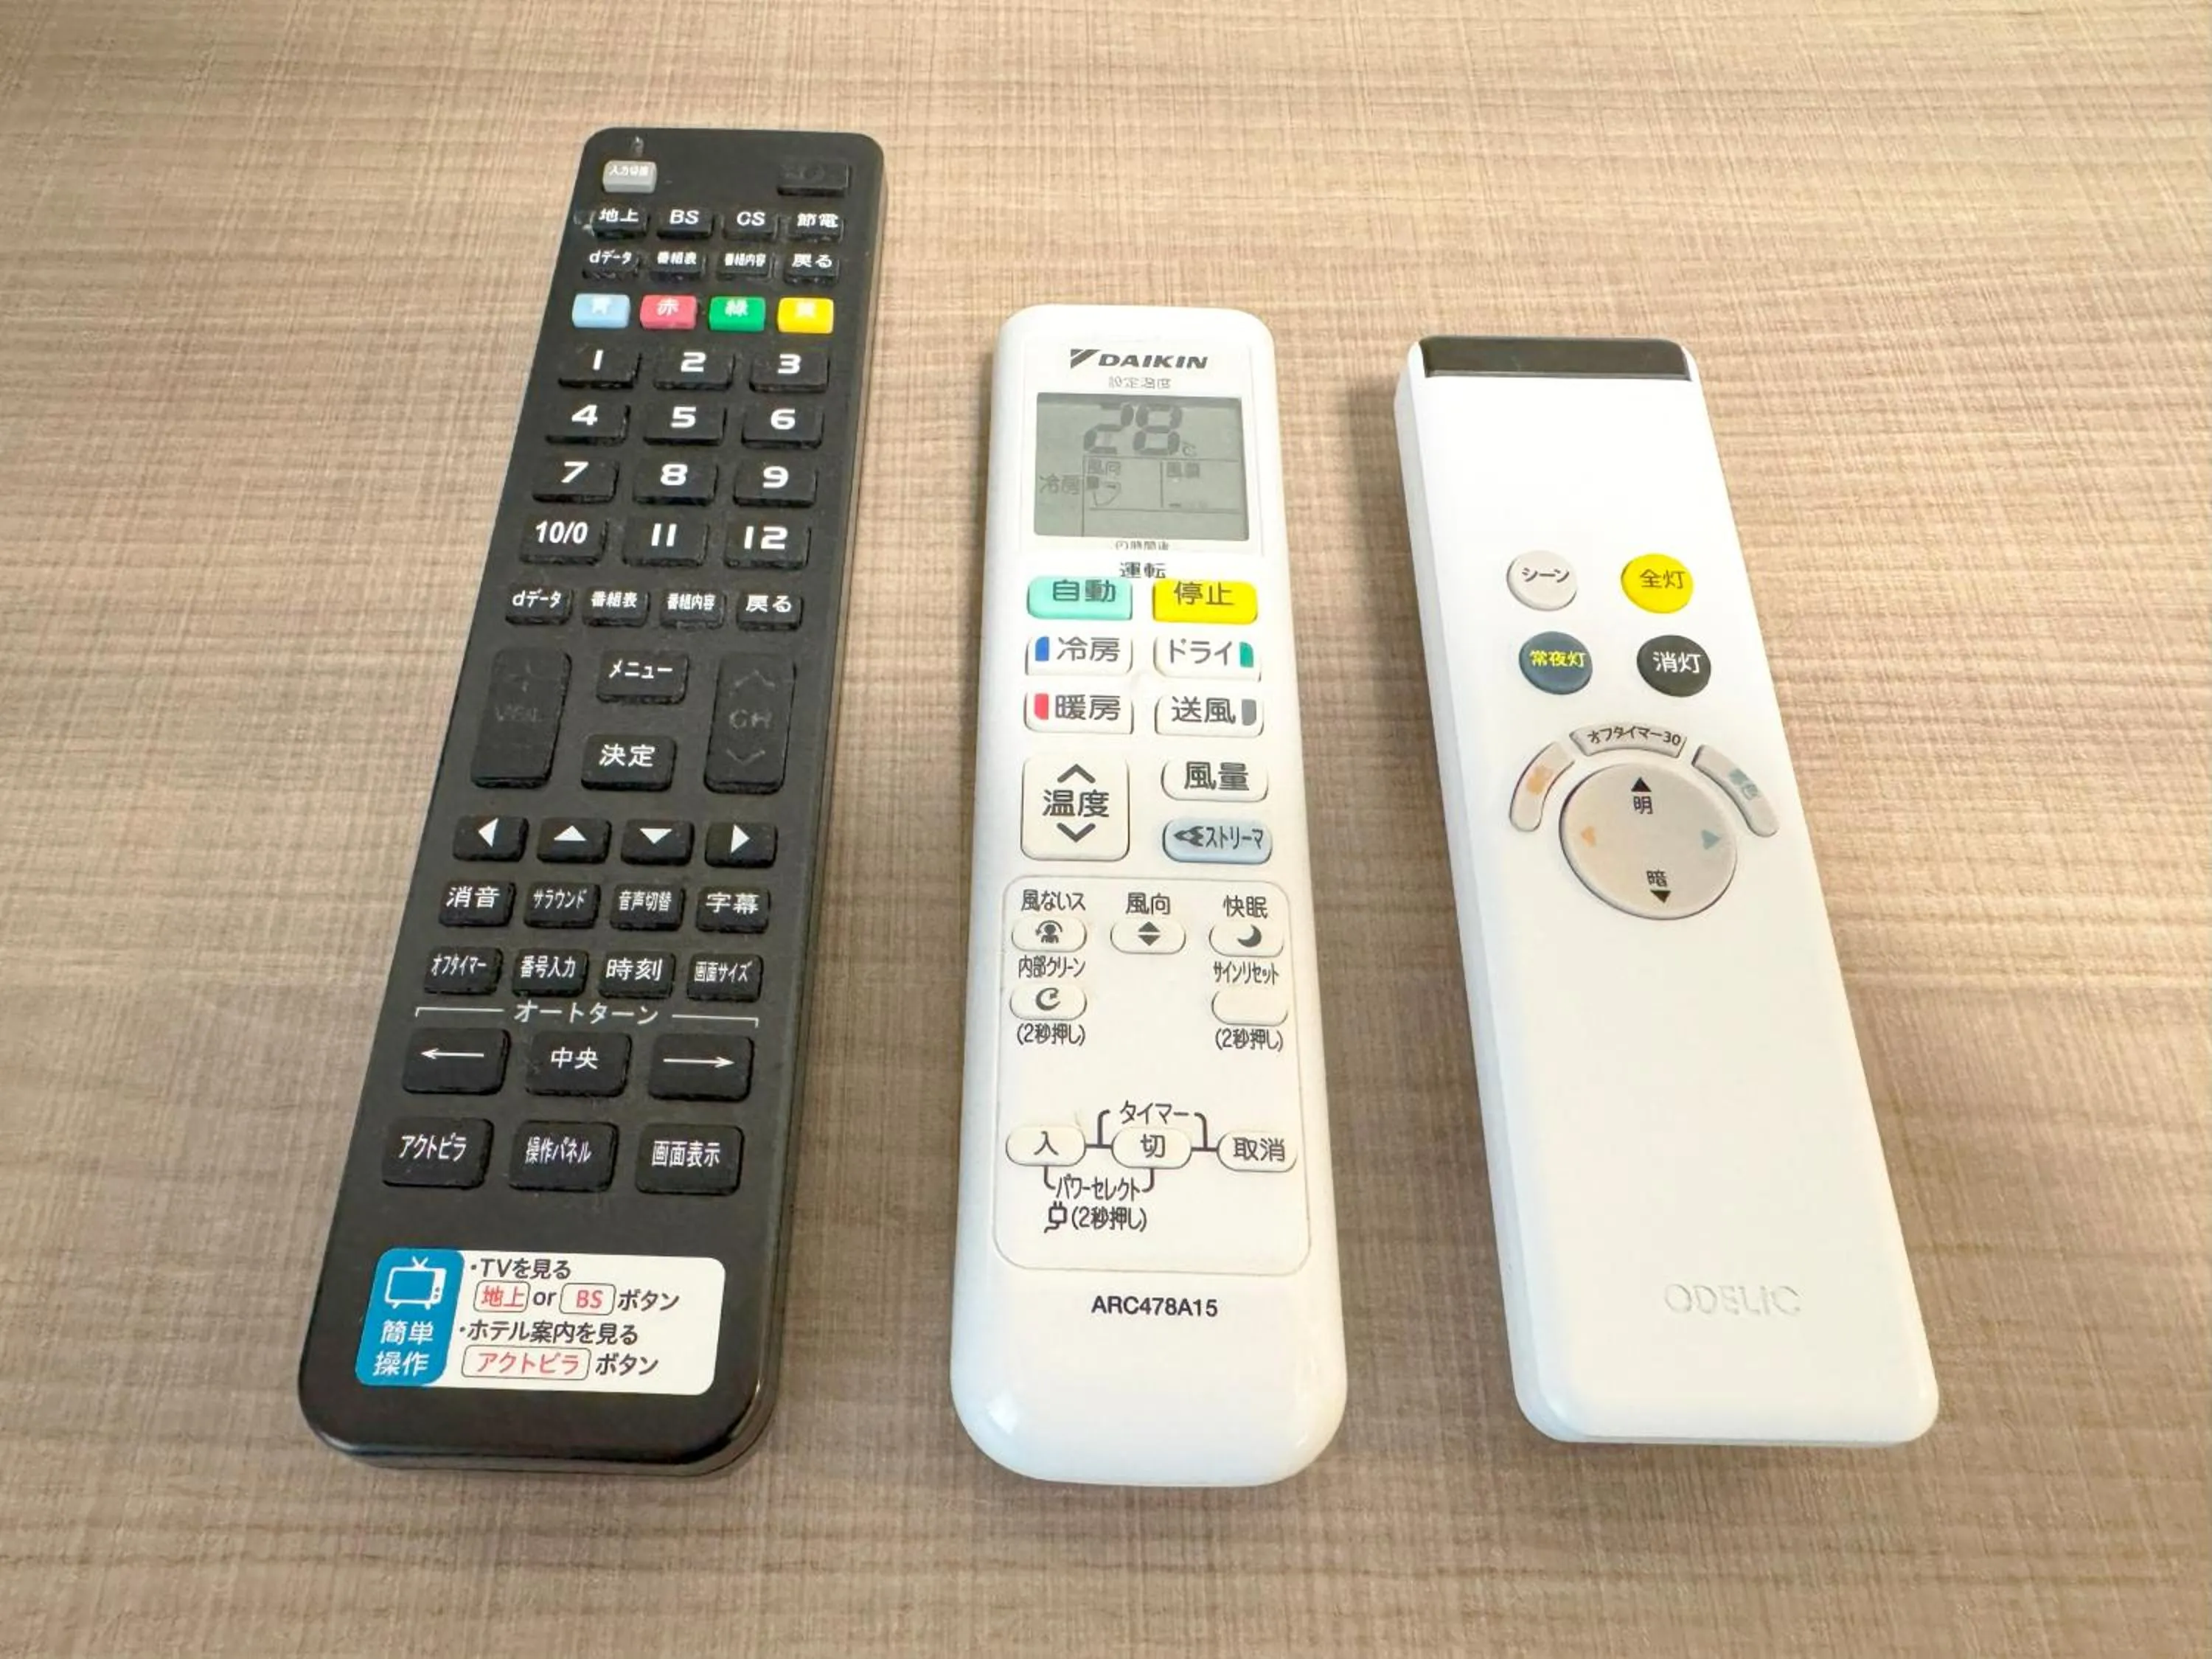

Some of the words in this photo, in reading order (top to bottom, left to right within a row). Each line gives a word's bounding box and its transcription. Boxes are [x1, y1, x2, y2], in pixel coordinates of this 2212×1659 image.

[599, 209, 639, 221] 地上
[669, 210, 698, 222] BS
[737, 212, 765, 224] CS
[796, 212, 838, 226] 節電
[588, 248, 632, 263] dデータ
[657, 253, 696, 264] 番組表
[724, 253, 766, 265] 番組内容
[791, 254, 832, 266] 戻る
[656, 299, 678, 314] 赤
[725, 300, 748, 316] 緑
[592, 349, 603, 369] 1
[680, 351, 706, 371] 2
[776, 353, 801, 373] 3
[1098, 353, 1208, 368] DAIKIN
[571, 404, 598, 425] 4
[669, 406, 697, 427] 5
[770, 408, 796, 428] 6
[1083, 403, 1182, 454] 28
[560, 462, 588, 482] 7
[659, 464, 688, 484] 8
[762, 466, 789, 487] 9
[535, 521, 588, 543] 10/0
[650, 523, 677, 546] 11
[743, 526, 787, 549] 12
[1119, 561, 1166, 577] 運転
[1521, 567, 1569, 581] シーン
[1639, 568, 1685, 588] 全灯
[512, 589, 561, 605] dデータ
[591, 591, 637, 606] 番組表
[667, 593, 716, 610] 番組内容
[1052, 579, 1116, 602] 自動
[1174, 582, 1234, 605] 停止
[745, 594, 792, 611] 戻る
[1057, 636, 1120, 661] 冷房
[1169, 638, 1232, 664] ドライ
[1529, 649, 1585, 667] 常夜灯
[608, 659, 672, 678] メニュー
[1652, 650, 1702, 672] 消灯
[1054, 694, 1121, 720] 暖房
[1171, 695, 1235, 723] 送風
[1587, 725, 1681, 745] オフタイマー30
[598, 744, 655, 766] 決定
[1183, 761, 1249, 790] 風量
[1043, 788, 1109, 816] 温度
[1633, 796, 1652, 813] 明
[1206, 827, 1263, 849] ストリーマ
[1646, 869, 1667, 886] 暗
[446, 886, 499, 908] 消音
[533, 888, 587, 908] サラウンド
[619, 890, 672, 910] 音声切替
[705, 892, 759, 914] 字幕
[1020, 888, 1086, 910] 風ないス
[1125, 892, 1170, 914] 風向
[1223, 895, 1267, 918] 快眠
[431, 953, 487, 975] オフタイマー
[520, 956, 576, 977] 番号入力
[605, 958, 661, 980] 時刻
[693, 961, 752, 981] 画面サイズ
[1018, 954, 1085, 977] 内部クリーン
[1212, 961, 1279, 984] サインリセット
[513, 999, 658, 1023] オートターン
[550, 1046, 599, 1070] 中央
[1120, 1101, 1189, 1123] タイマー
[398, 1133, 467, 1161] アクトビラ
[525, 1136, 591, 1163] 操作パネル
[651, 1140, 720, 1167] 画面表示
[1034, 1130, 1058, 1155] 入
[1140, 1133, 1164, 1156] 切
[1233, 1137, 1284, 1161] 取消
[1055, 1174, 1140, 1200] パワーセレクト
[481, 1286, 525, 1307] 地上
[532, 1288, 555, 1306] or
[576, 1289, 602, 1308] BS
[617, 1289, 680, 1310] ボタン
[1091, 1295, 1217, 1316] ARC478A15
[1664, 1284, 1801, 1315] ODELIC
[380, 1319, 434, 1343] 簡単
[372, 1351, 429, 1376] 操作
[476, 1351, 580, 1374] アクトビラ
[595, 1354, 658, 1375] ボタン
